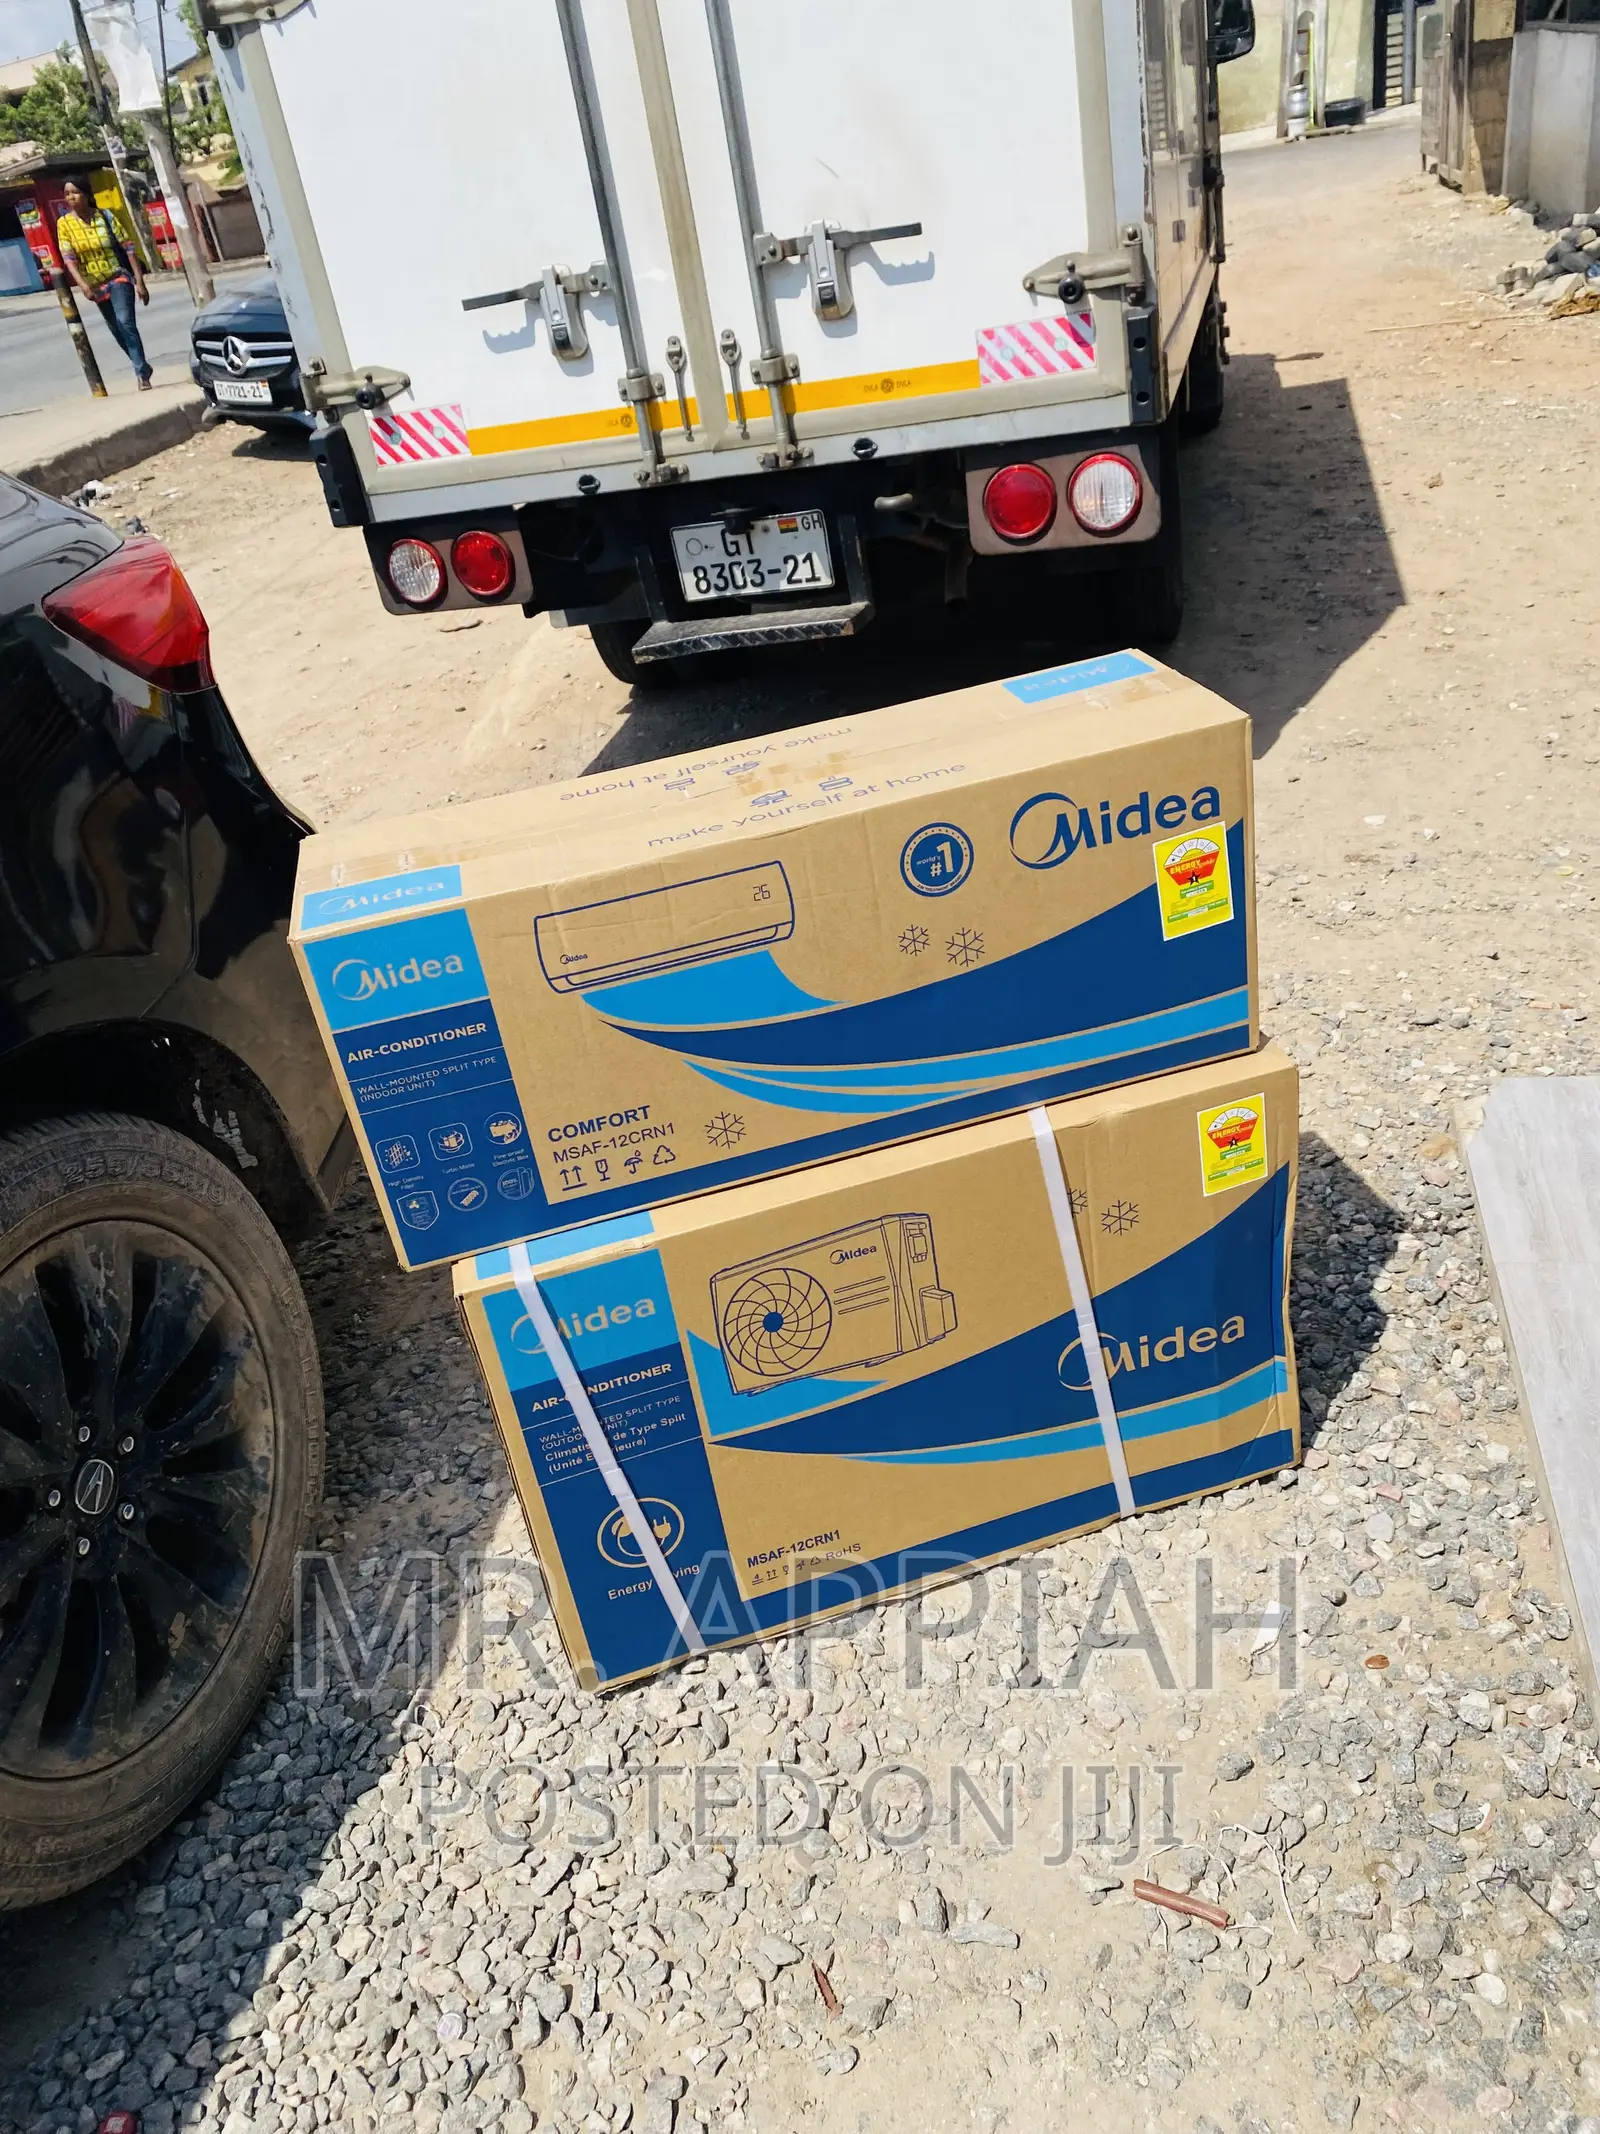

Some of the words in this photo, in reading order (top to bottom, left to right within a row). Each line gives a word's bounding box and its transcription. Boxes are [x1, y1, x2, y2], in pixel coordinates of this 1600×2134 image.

[801, 513, 823, 530] GH
[693, 552, 821, 594] 8303-21
[648, 822, 724, 847] make
[732, 792, 845, 827] yourself
[852, 784, 881, 798] at
[886, 764, 966, 788] home
[1010, 785, 1221, 869] Midea
[319, 881, 444, 915] Midea
[753, 884, 771, 901] 26
[332, 955, 464, 1001] Midea
[347, 1022, 488, 1064] AIR-CONDITIONER
[357, 1069, 441, 1094] WALL-MOUNTED
[442, 1062, 469, 1075] SPLIT
[472, 1056, 498, 1067] TYPE
[360, 1085, 405, 1103] (INDOOR
[408, 1079, 436, 1092] UNIT)
[547, 1105, 650, 1142] COMFORT
[553, 1122, 675, 1164] MSAF-12CRN1
[829, 1245, 877, 1265] Midea
[532, 1363, 672, 1412] AIR-NDITIONER
[625, 1403, 652, 1417] SPLIT
[655, 1395, 681, 1408] TYPE
[612, 1431, 627, 1441] de
[629, 1423, 658, 1436] Type
[660, 1412, 686, 1428] Split
[747, 1529, 841, 1568] MSAF-12CRN1
[825, 1543, 862, 1561] RoHS
[608, 1578, 653, 1600] Energy
